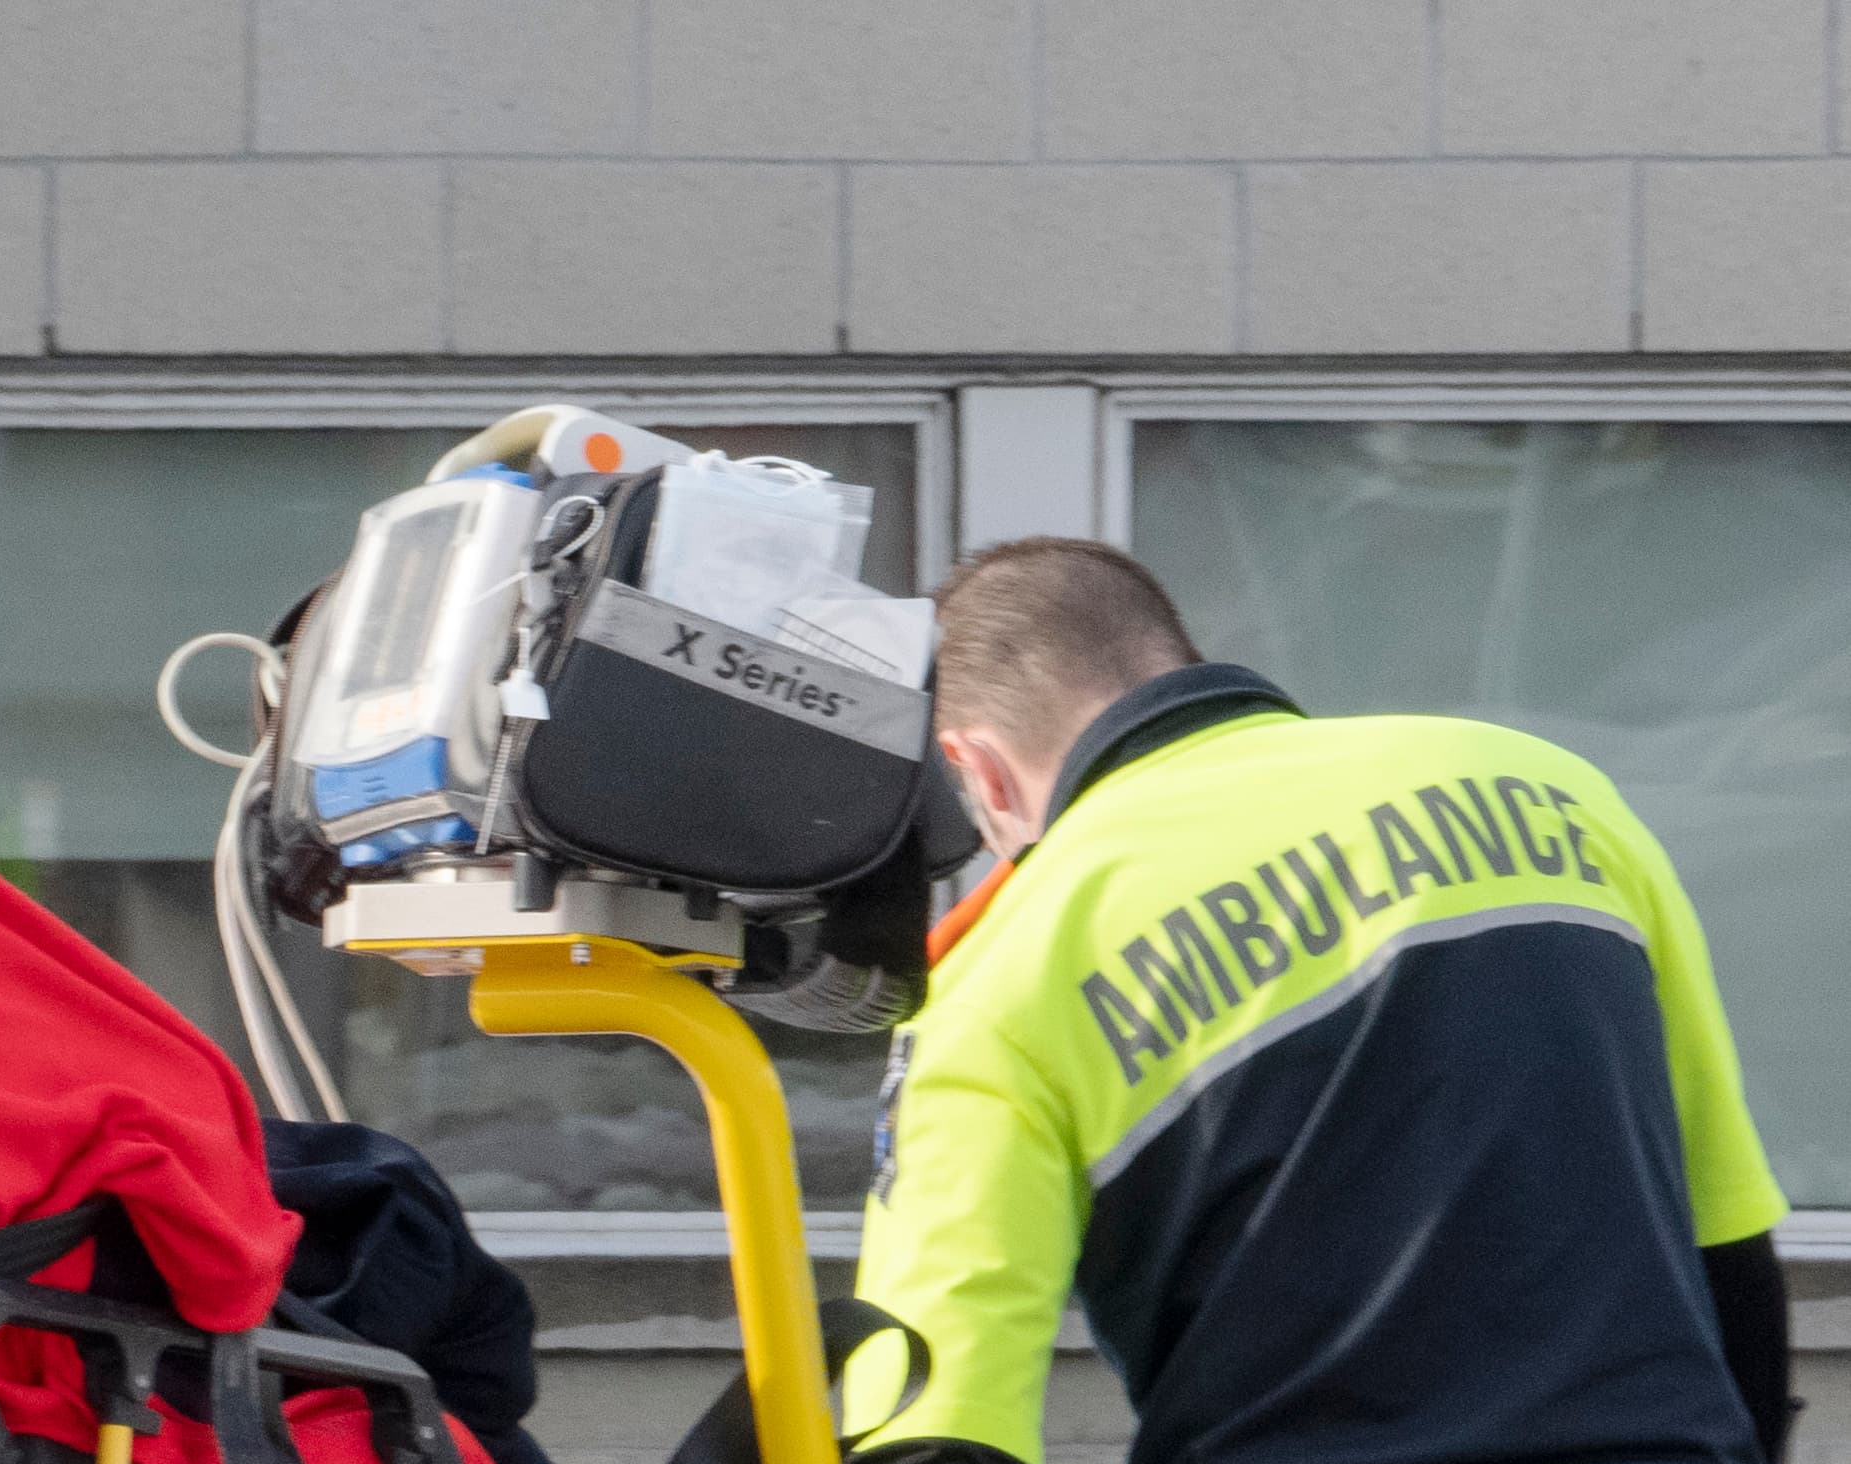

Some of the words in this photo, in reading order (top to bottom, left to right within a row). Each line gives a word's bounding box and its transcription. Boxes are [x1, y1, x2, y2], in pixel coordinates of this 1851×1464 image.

[661, 622, 705, 666] X
[713, 642, 840, 718] Series
[1081, 775, 1607, 1087] AMBULANCE
